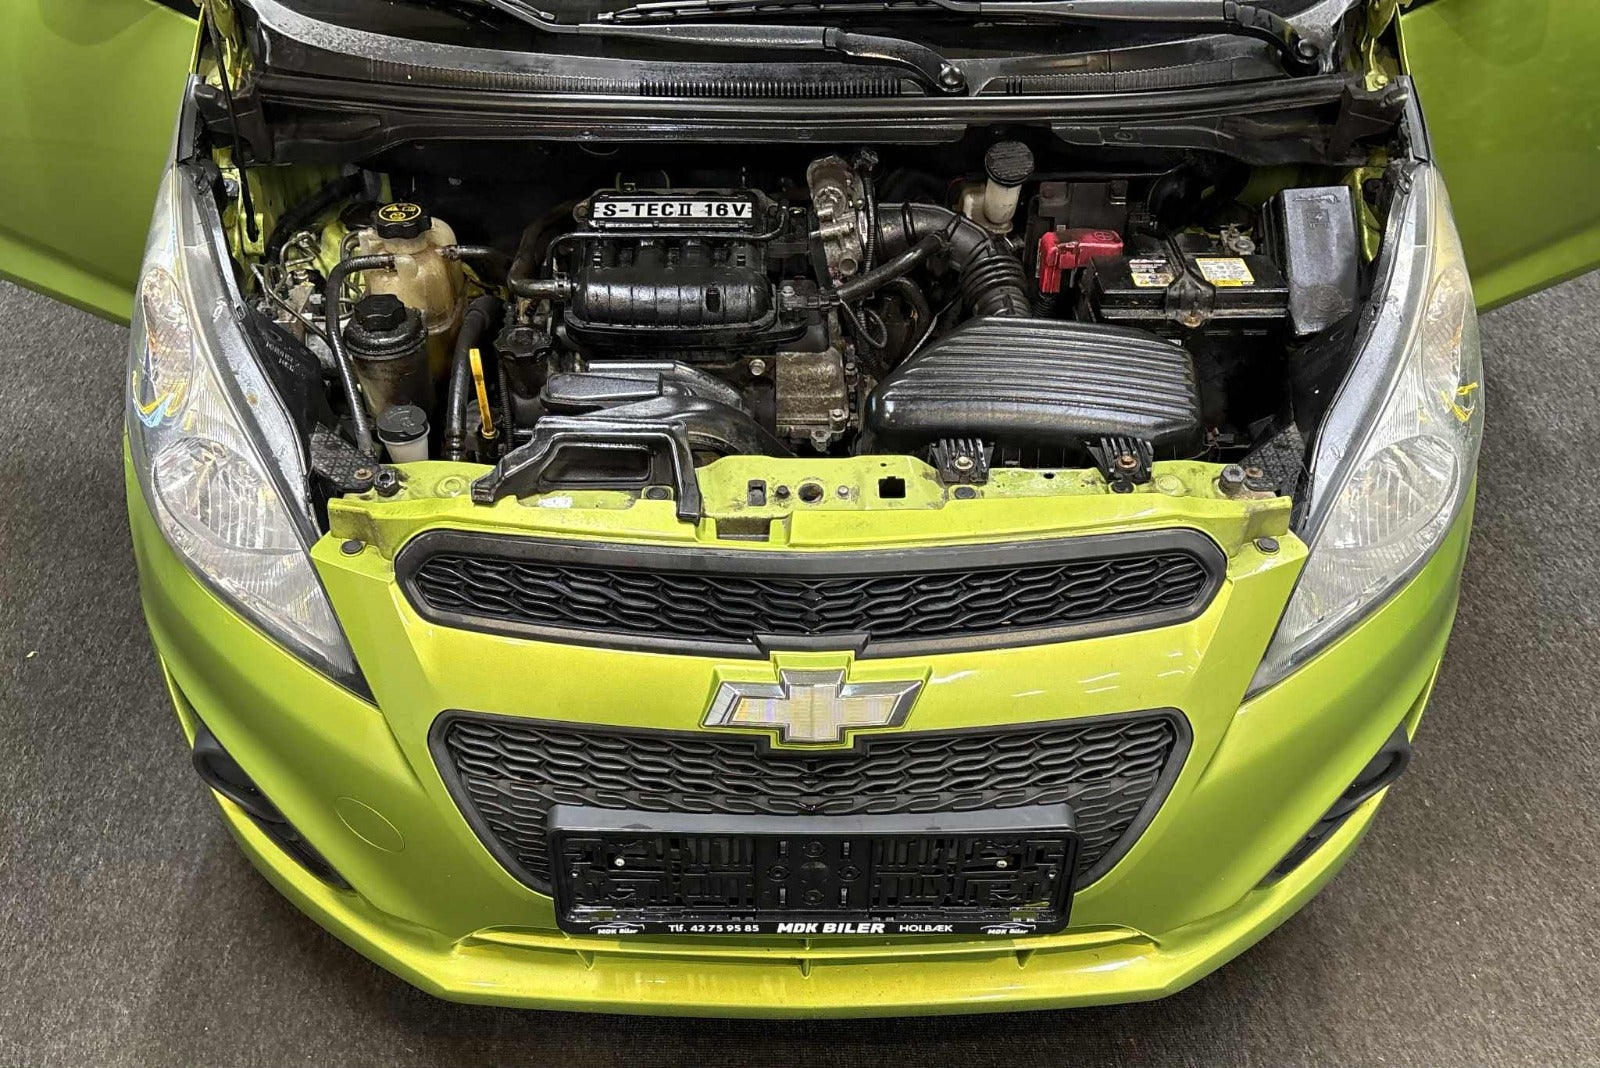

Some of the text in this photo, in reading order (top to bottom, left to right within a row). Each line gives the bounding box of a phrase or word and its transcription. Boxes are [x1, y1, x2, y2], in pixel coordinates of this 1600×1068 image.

[704, 203, 747, 217] 16V
[668, 924, 760, 932] Tlf. 42 75 95 85
[776, 922, 886, 934] MDK BILER
[899, 924, 953, 932] HOLBÆK
